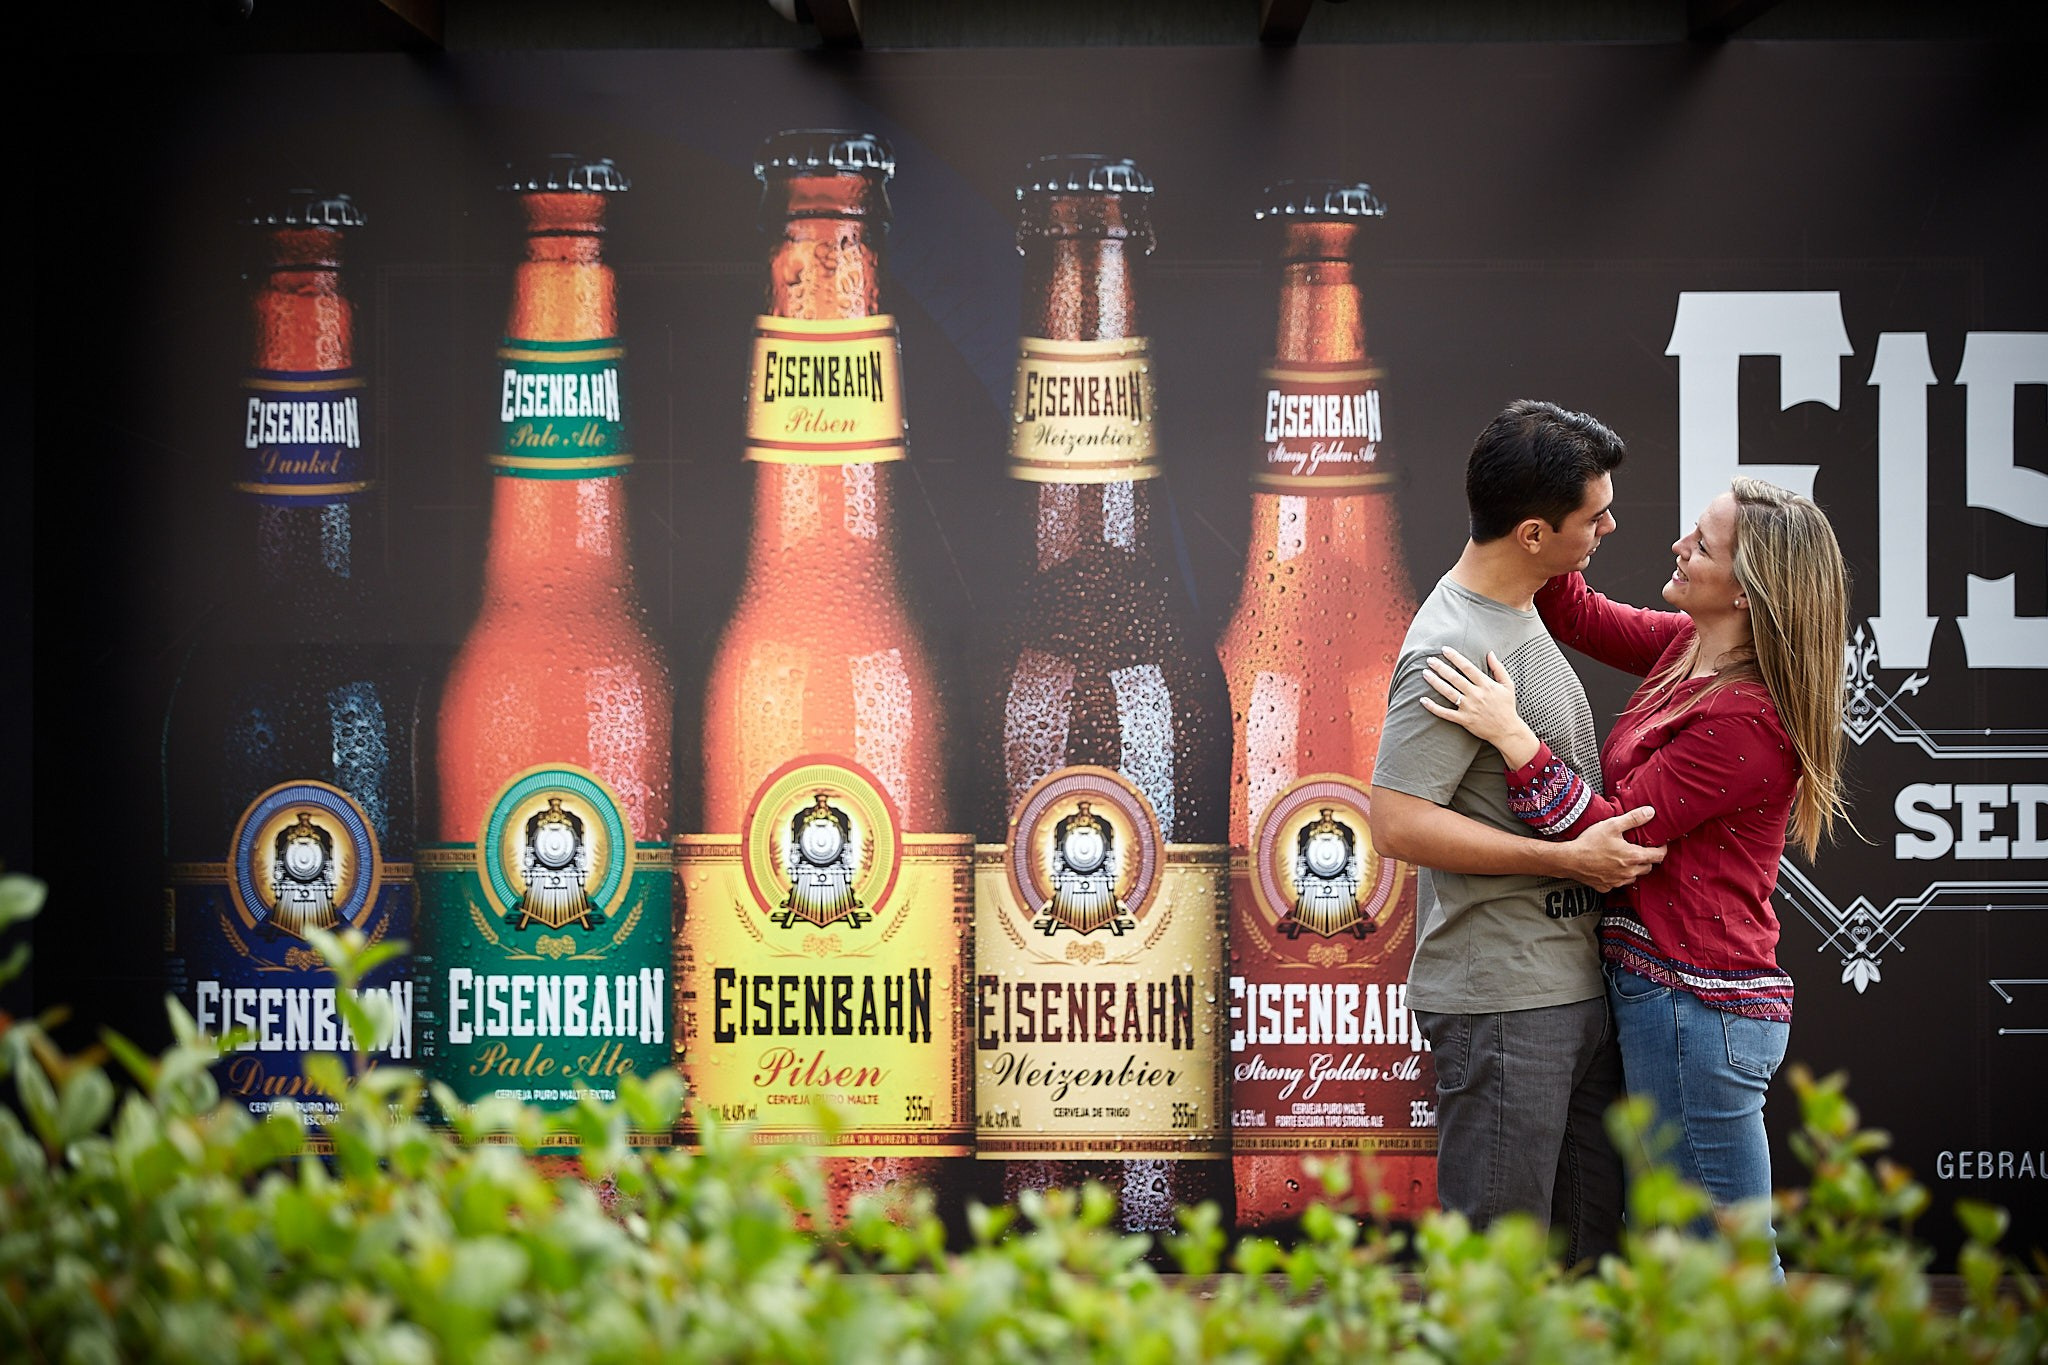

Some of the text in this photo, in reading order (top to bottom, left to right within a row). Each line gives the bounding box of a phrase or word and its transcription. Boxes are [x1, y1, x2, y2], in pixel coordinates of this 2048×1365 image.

[764, 350, 885, 403] EISENBAHN
[500, 369, 620, 422] EISENBAHN
[1024, 370, 1143, 424] EISENBAHN
[245, 398, 360, 449] EISENBAHN
[784, 407, 860, 434] Pilsen
[1264, 390, 1383, 443] EISENBAHN
[510, 422, 607, 447] Pale Ale
[1033, 424, 1138, 456] Weizenbier
[260, 448, 341, 476] Dunkel
[1267, 442, 1376, 476] Strong Golden Ale
[448, 967, 665, 1044] EISENBAHN
[713, 967, 932, 1043] EISENBAHN
[977, 974, 1195, 1051] EISENBAHN
[469, 1039, 635, 1077] Pale Ale
[753, 1047, 887, 1088] Pilsen
[991, 1051, 1184, 1102] Weizenbier
[1234, 1053, 1421, 1100] Strong Golden Ale
[249, 1102, 293, 1113] CERVE
[296, 1102, 324, 1112] PURO
[495, 1089, 532, 1100] CERVEJA
[533, 1089, 559, 1100] PURO
[590, 1089, 616, 1100] EXTRA
[767, 1094, 810, 1105] CERVEJA
[847, 1094, 879, 1105] MALTE
[905, 1095, 933, 1122] 355ml
[1323, 1102, 1342, 1114] PURO
[1343, 1102, 1366, 1114] MALTE
[1053, 1107, 1130, 1117] CERVEJA DE TRIGO
[1172, 1102, 1198, 1128] 355ml
[1326, 1115, 1342, 1127] TIPO
[873, 1134, 906, 1144] PUREZA
